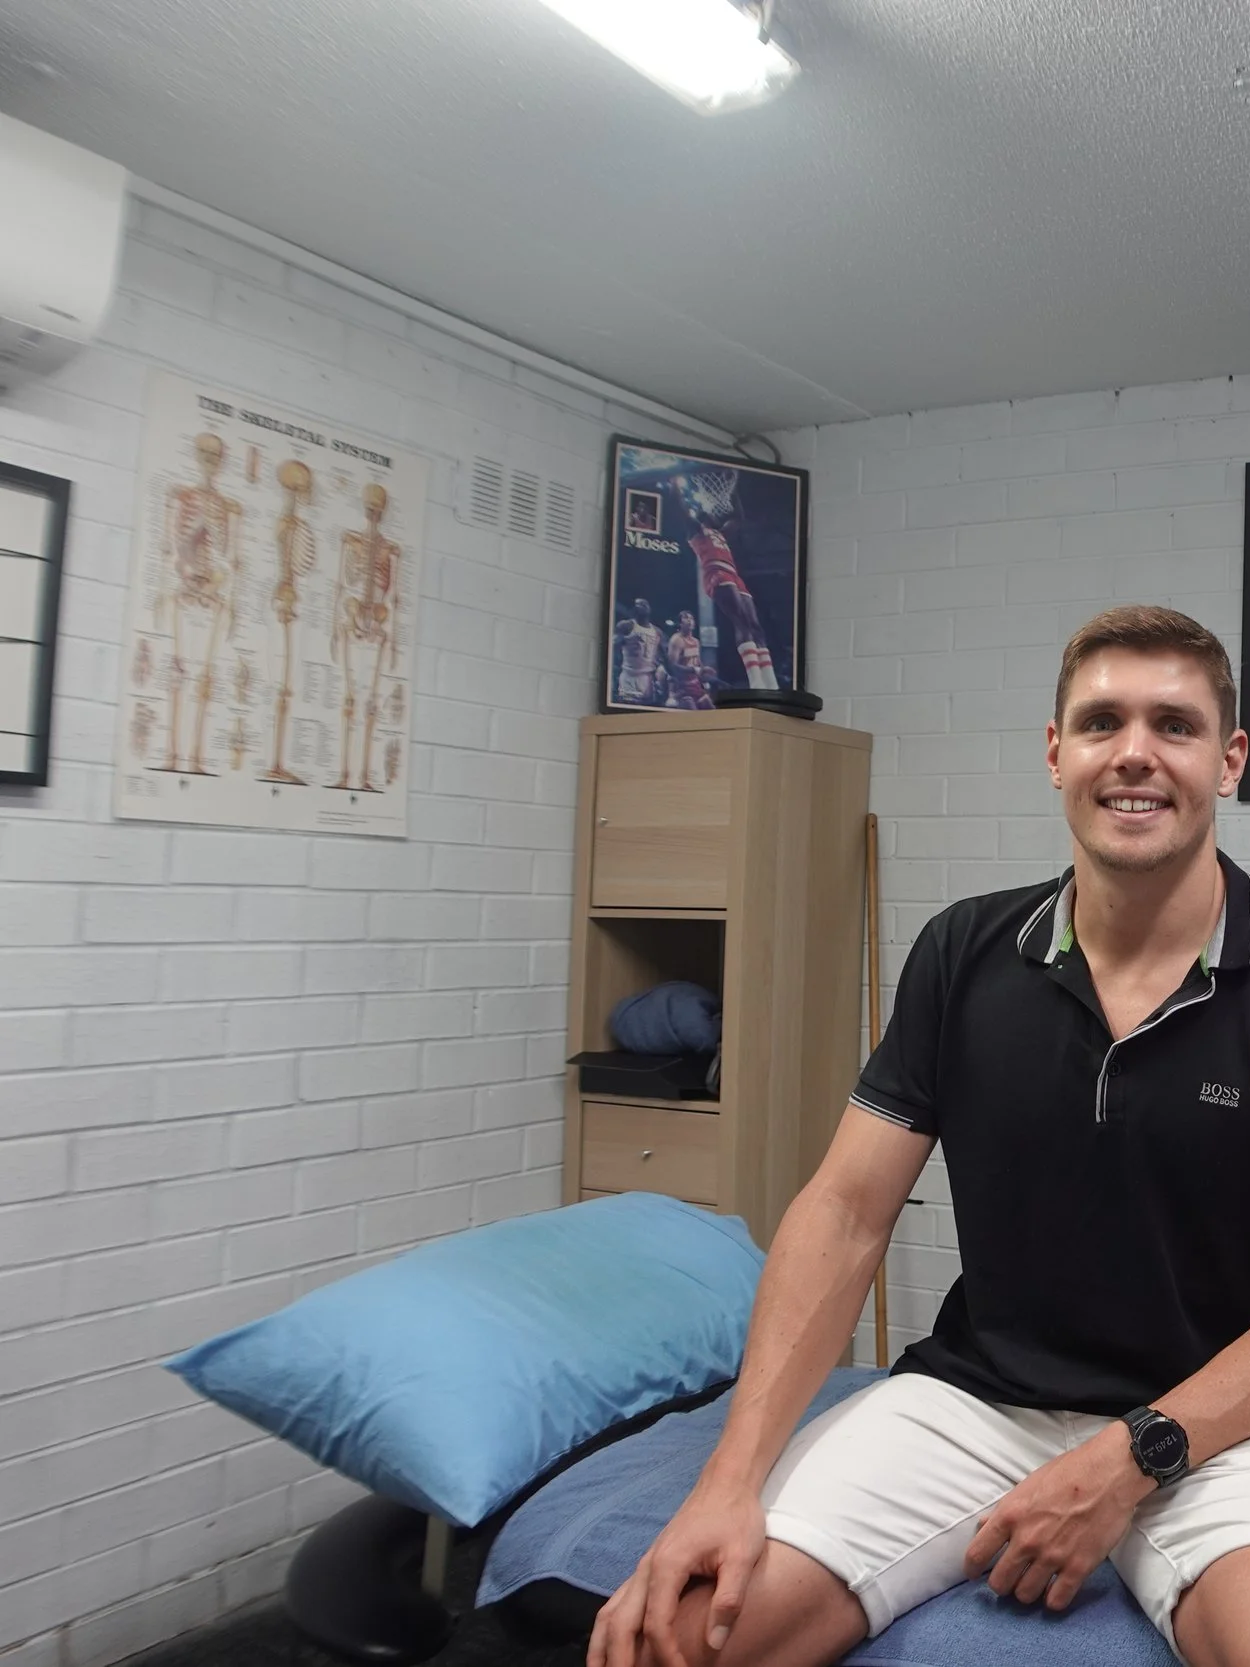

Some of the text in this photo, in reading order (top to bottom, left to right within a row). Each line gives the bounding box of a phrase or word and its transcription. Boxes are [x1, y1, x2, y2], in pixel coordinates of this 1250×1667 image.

[332, 438, 394, 469] SYSTEM
[624, 531, 680, 554] Moses
[1199, 1094, 1239, 1108] HUGO BOSS
[1200, 1082, 1240, 1101] BOSS
